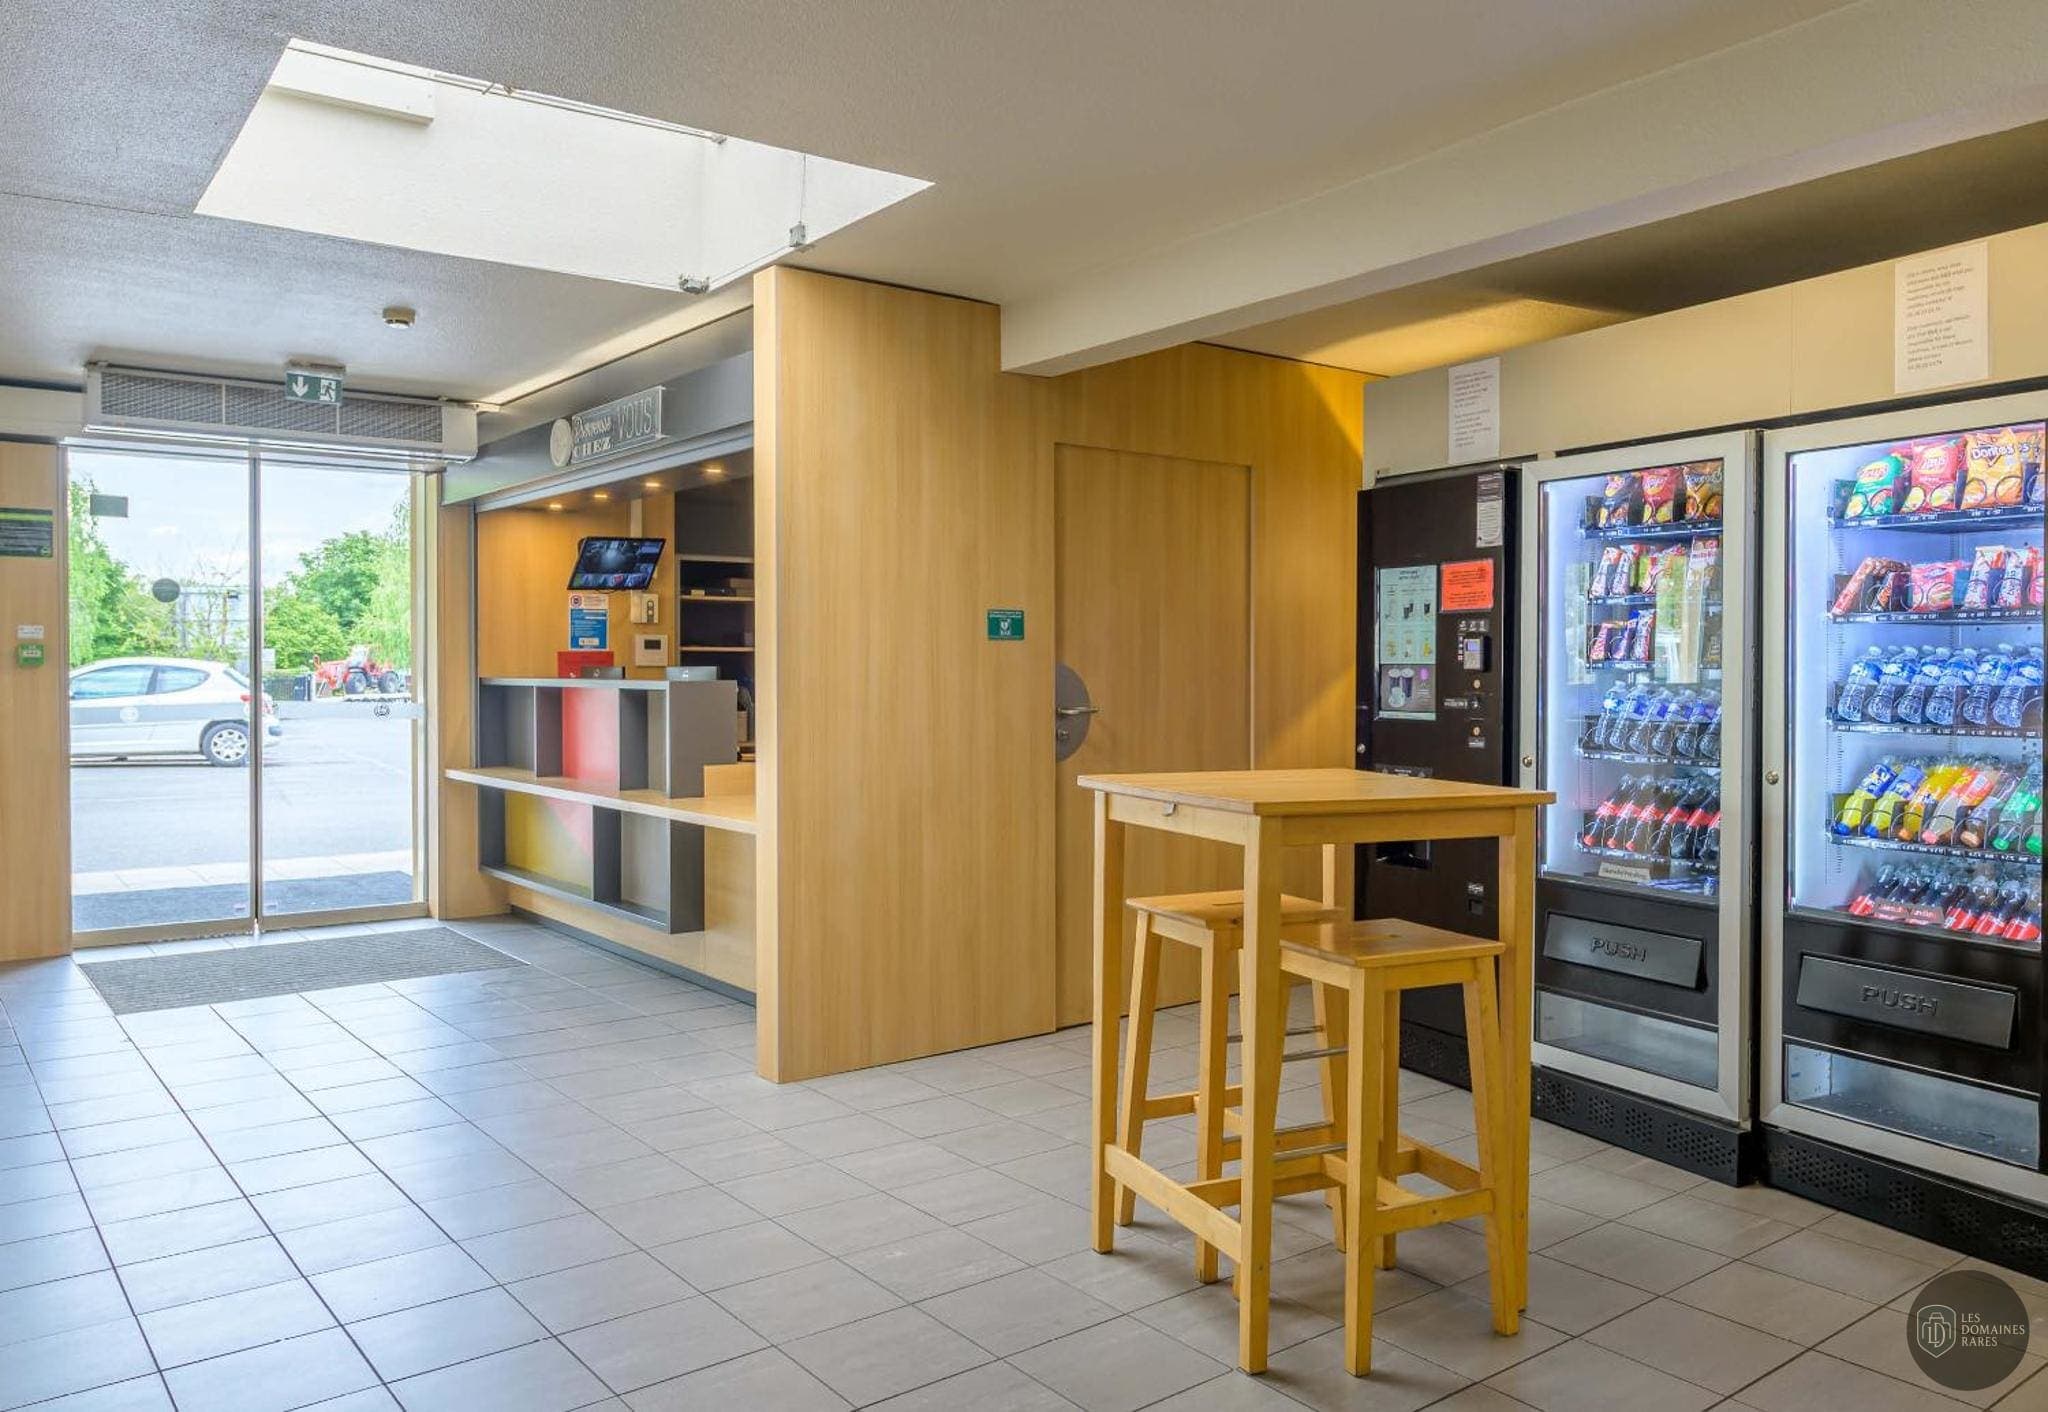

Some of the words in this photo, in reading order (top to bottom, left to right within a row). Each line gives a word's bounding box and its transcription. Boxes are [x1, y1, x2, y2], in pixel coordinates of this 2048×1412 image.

[616, 396, 652, 440] VOUS
[1972, 442, 2015, 460] Doritos
[1590, 936, 1648, 962] PUSH
[1861, 985, 1938, 1016] PUSH
